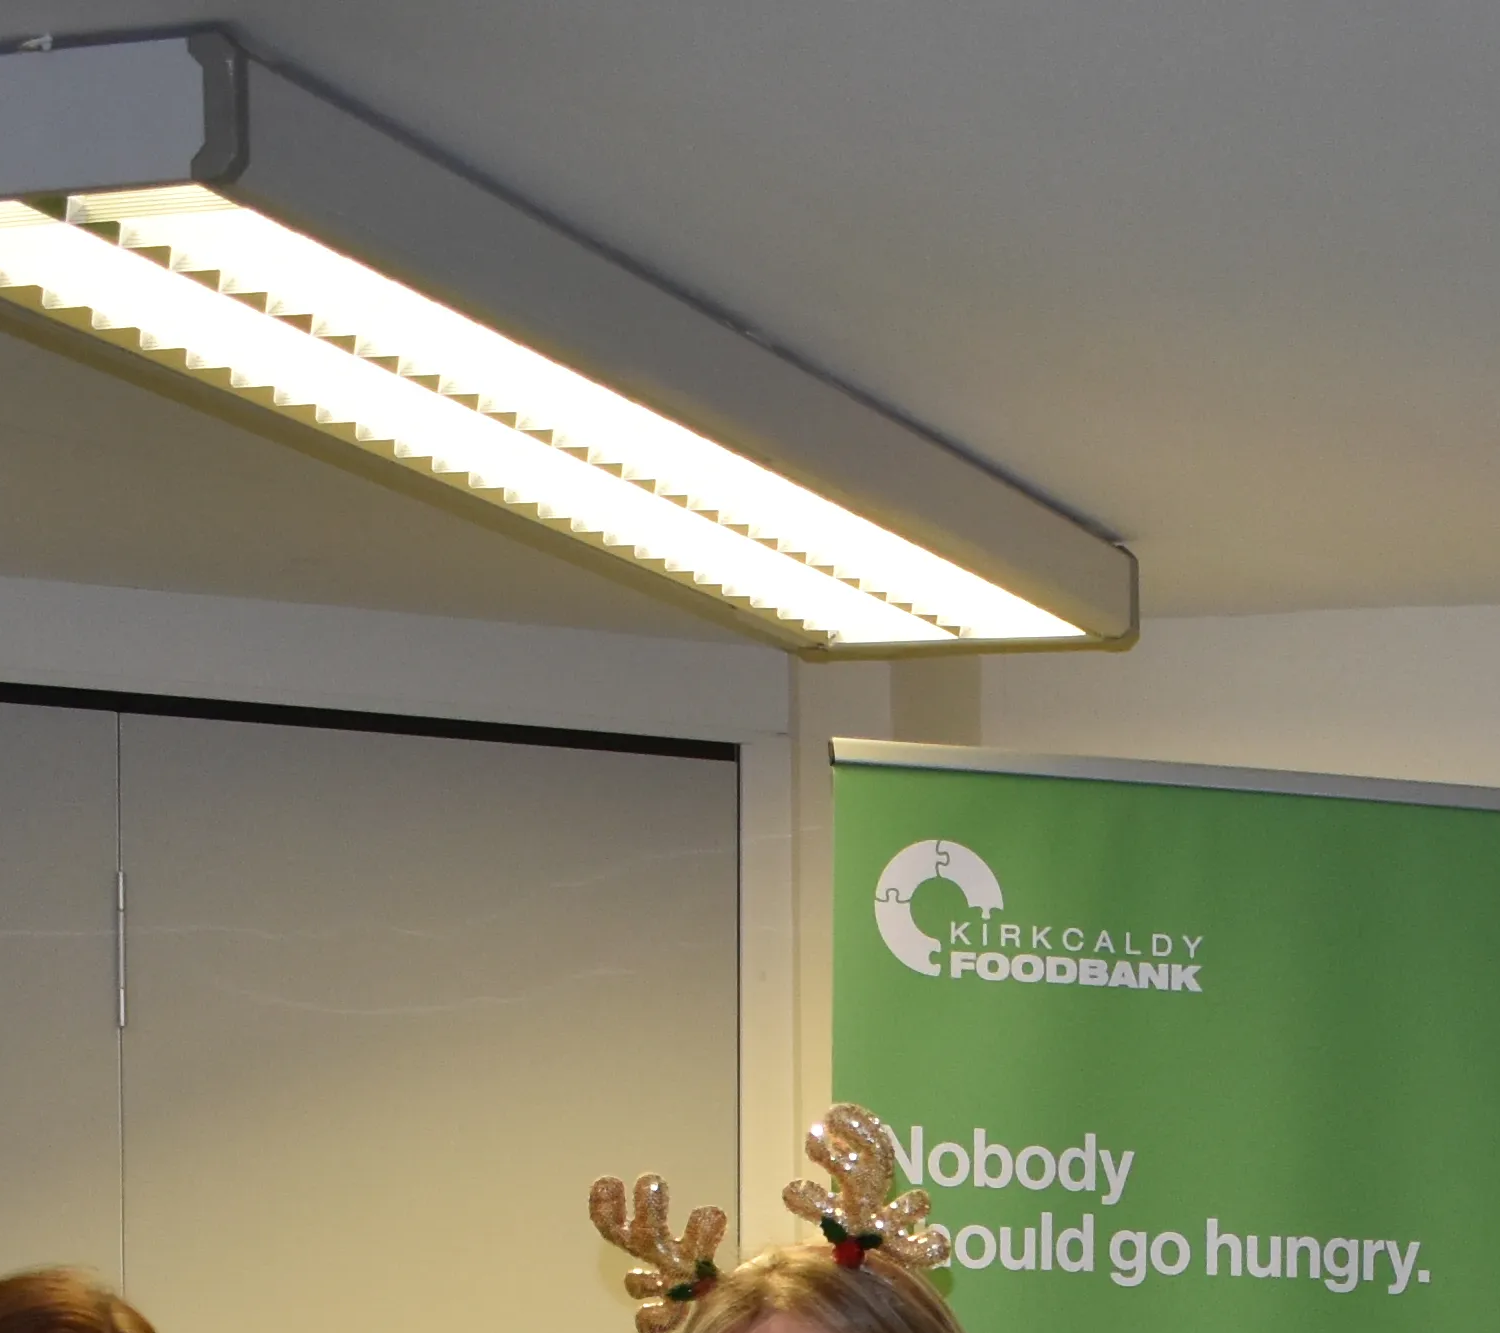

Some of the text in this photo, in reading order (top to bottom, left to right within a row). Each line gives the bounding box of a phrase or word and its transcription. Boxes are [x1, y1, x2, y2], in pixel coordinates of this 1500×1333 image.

[951, 919, 1205, 959] KIRKCALDY
[950, 950, 1203, 992] FOODBANK
[880, 1123, 1135, 1206] Nobody
[1108, 1226, 1190, 1287] go
[1205, 1216, 1432, 1295] hungry.
